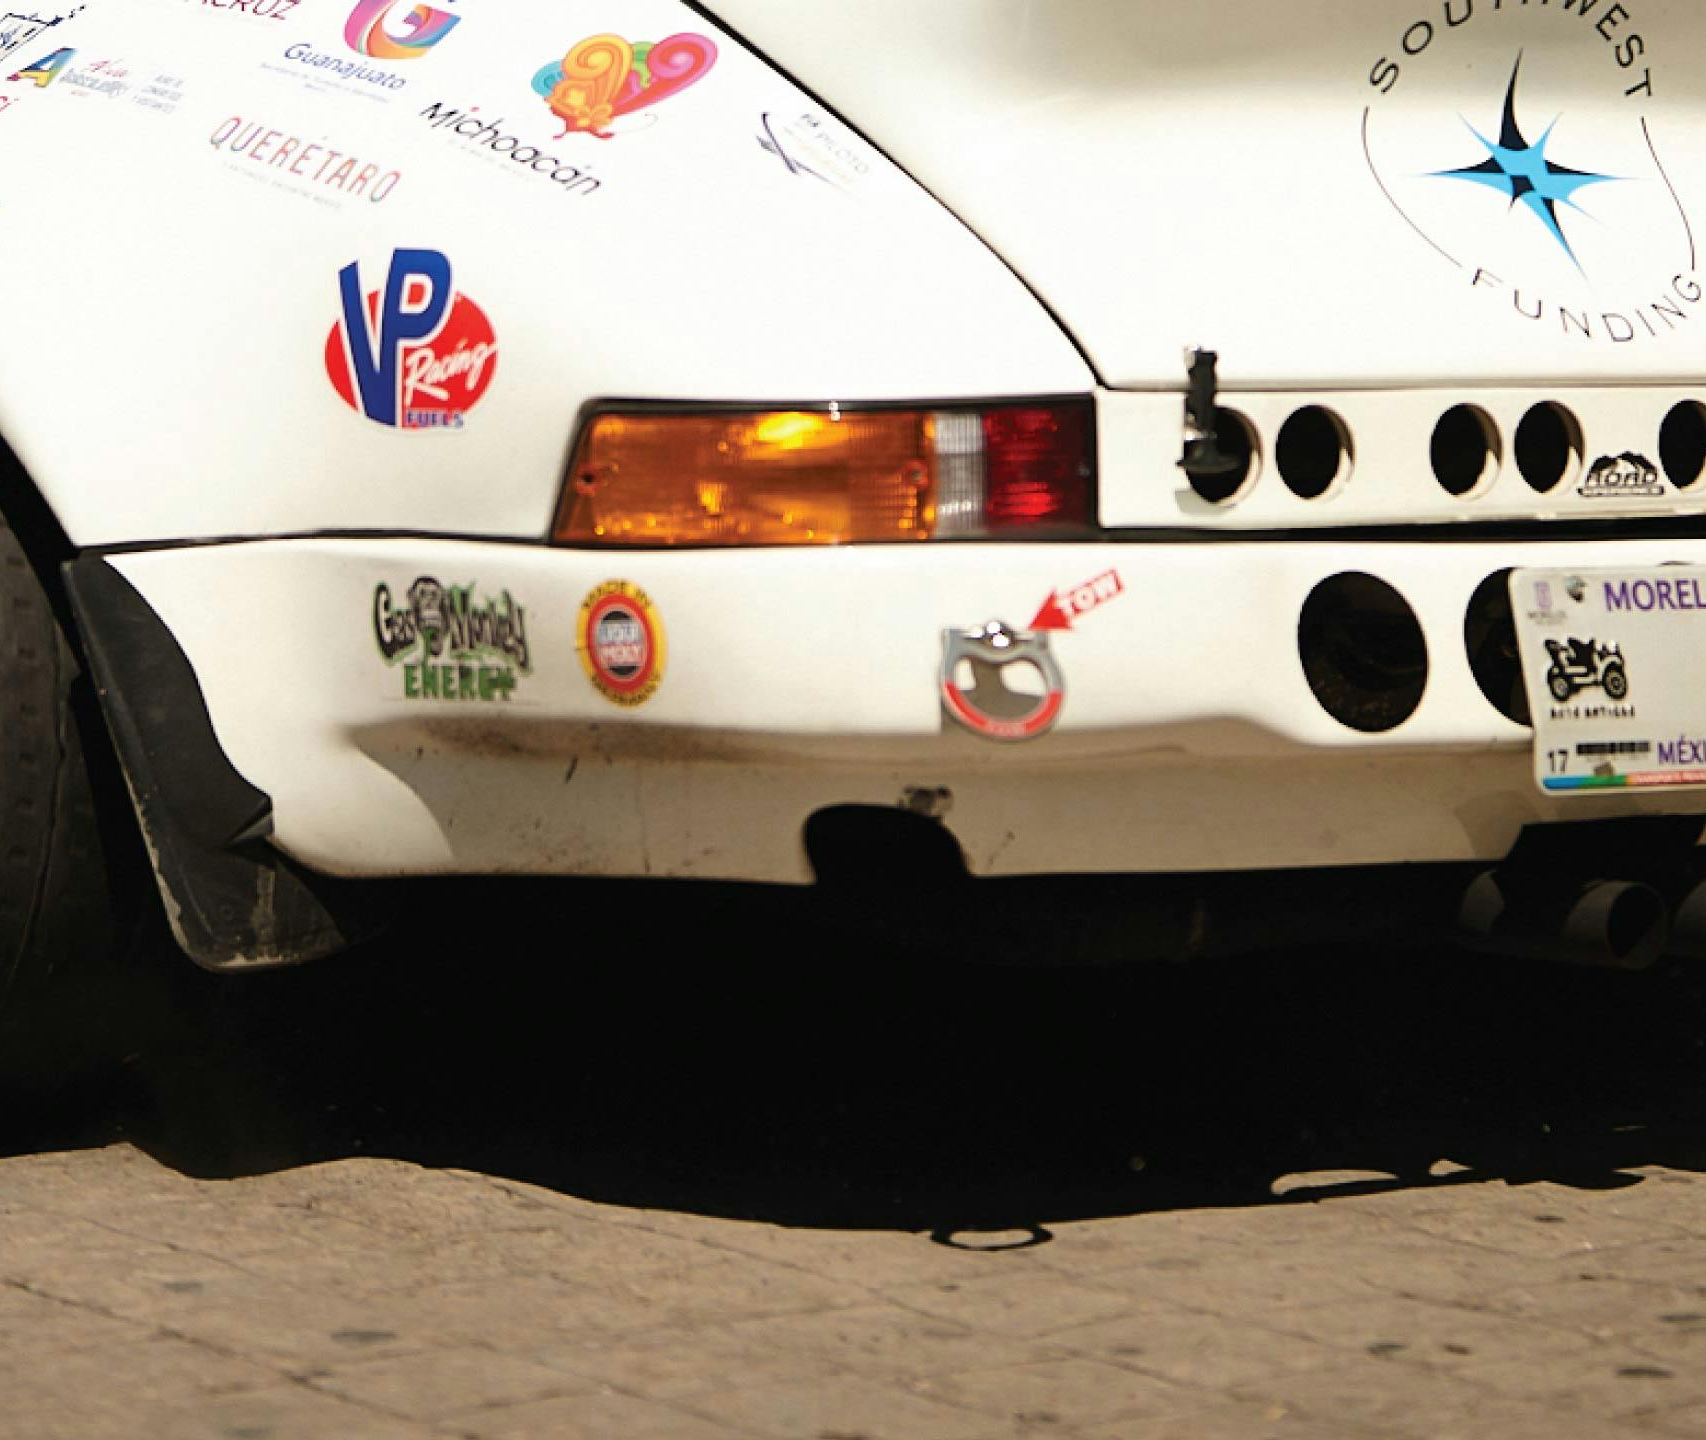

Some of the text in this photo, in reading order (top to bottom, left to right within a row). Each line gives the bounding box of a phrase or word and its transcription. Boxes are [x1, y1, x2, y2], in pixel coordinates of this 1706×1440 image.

[284, 43, 407, 90] Guanajuato
[210, 116, 401, 202] QUERÉTARO
[420, 101, 602, 195] Michoacán
[338, 247, 451, 426] VP
[1472, 267, 1702, 343] FUNDING
[403, 338, 499, 408] Racing
[403, 663, 517, 702] ENERGY
[1547, 749, 1570, 774] 17
